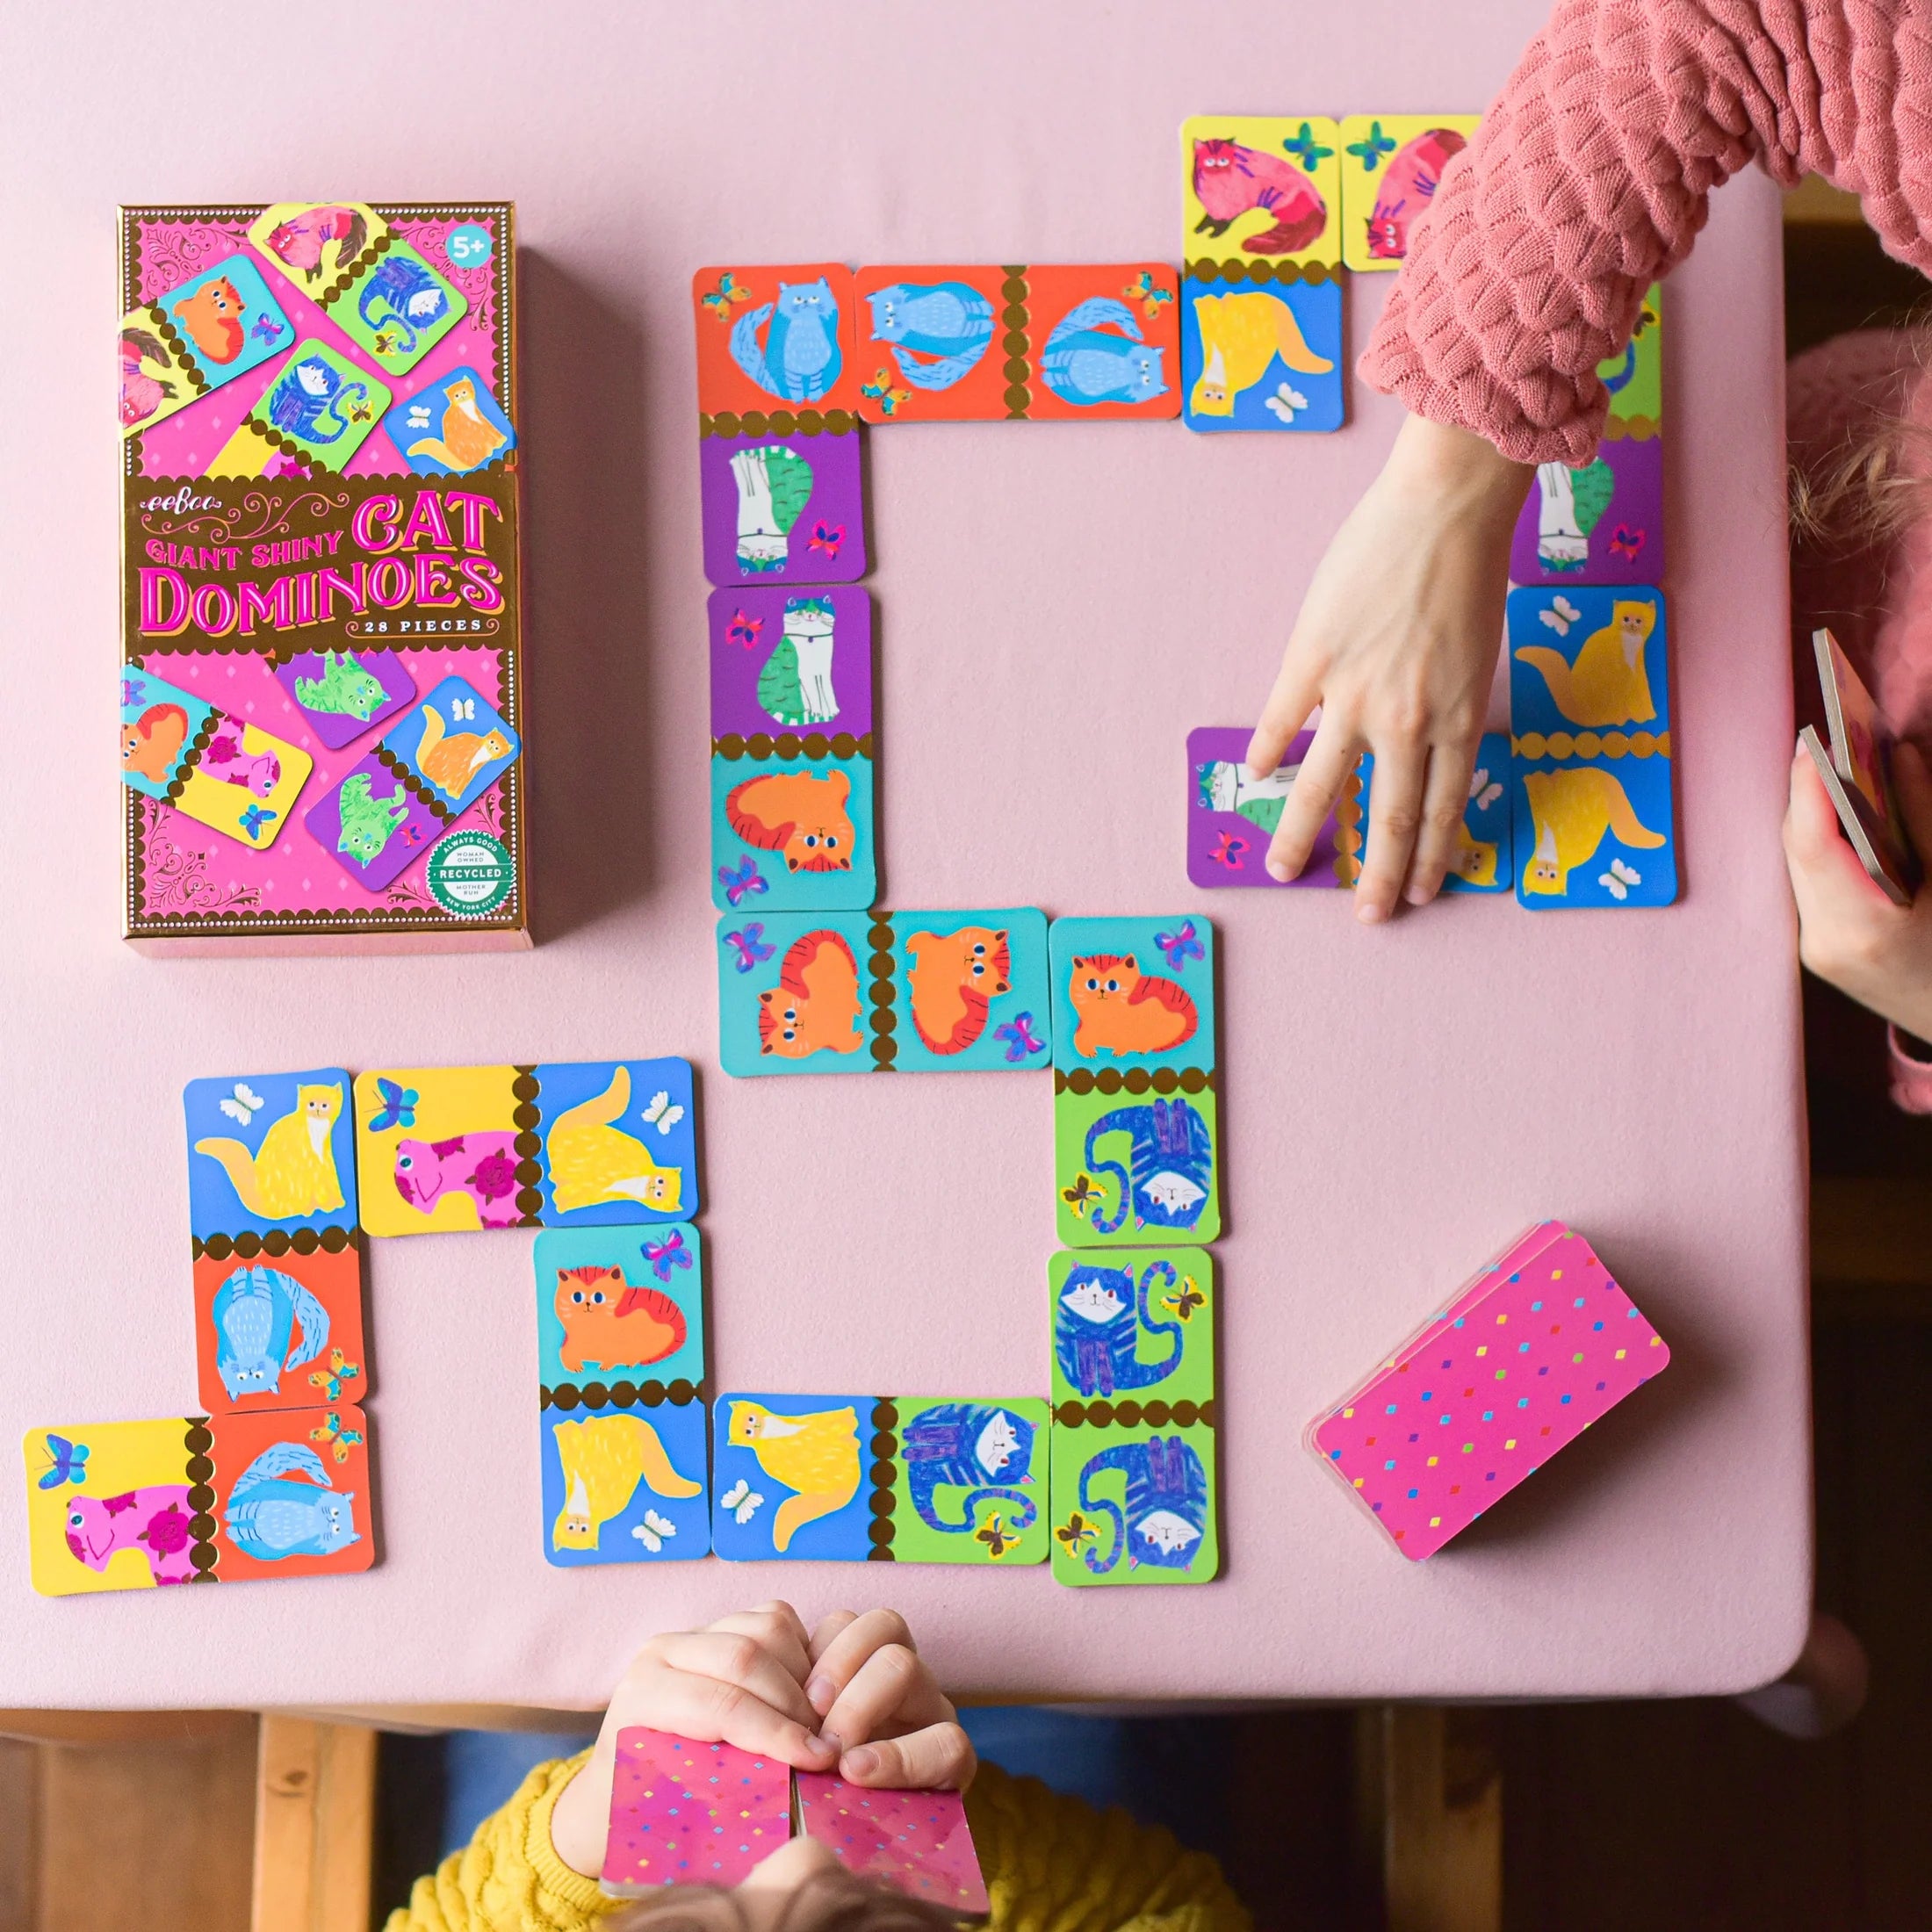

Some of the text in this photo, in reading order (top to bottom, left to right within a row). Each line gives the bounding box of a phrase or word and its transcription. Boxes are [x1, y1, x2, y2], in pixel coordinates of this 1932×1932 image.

[453, 236, 485, 258] 5+
[146, 490, 504, 571] GIANT SHINY CAT
[364, 619, 482, 632] 28 PIECES
[443, 837, 498, 854] ALWAYS GOOD
[439, 869, 501, 879] RECYCLED
[445, 897, 459, 907] NEW
[481, 897, 496, 907] CITY
